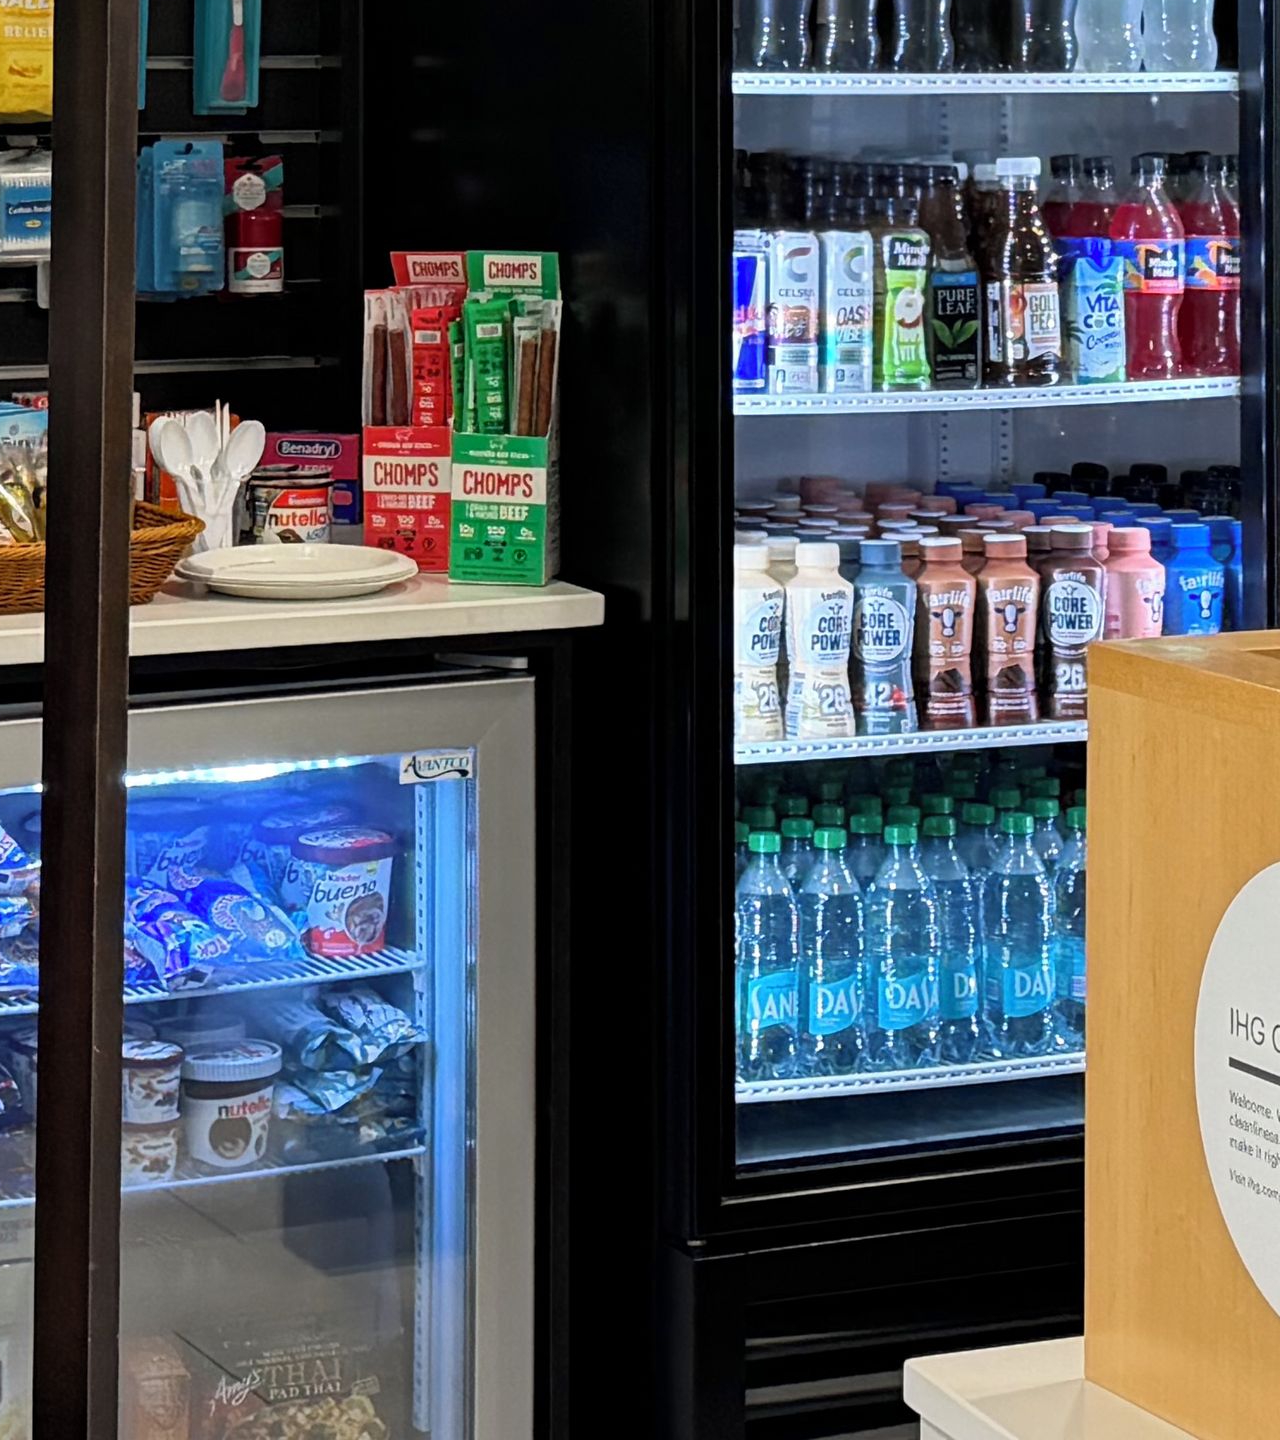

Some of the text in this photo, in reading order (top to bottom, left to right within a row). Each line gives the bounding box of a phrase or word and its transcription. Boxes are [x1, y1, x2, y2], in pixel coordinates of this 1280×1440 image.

[411, 260, 459, 278] CHOMPS
[488, 261, 537, 280] CHOMPS
[937, 289, 975, 302] PURE
[281, 441, 336, 457] Benadryl
[373, 461, 439, 487] CHOMPS
[463, 470, 533, 498] CHOMPS
[499, 505, 530, 521] BEEF
[1179, 571, 1224, 591] fairlif
[1054, 597, 1087, 613] CORE
[1050, 613, 1093, 630] POWER
[314, 879, 377, 904] bueno
[1230, 1007, 1265, 1046] IHG
[1229, 1089, 1273, 1120] Welcome.
[270, 1381, 341, 1400] PAD THAI
